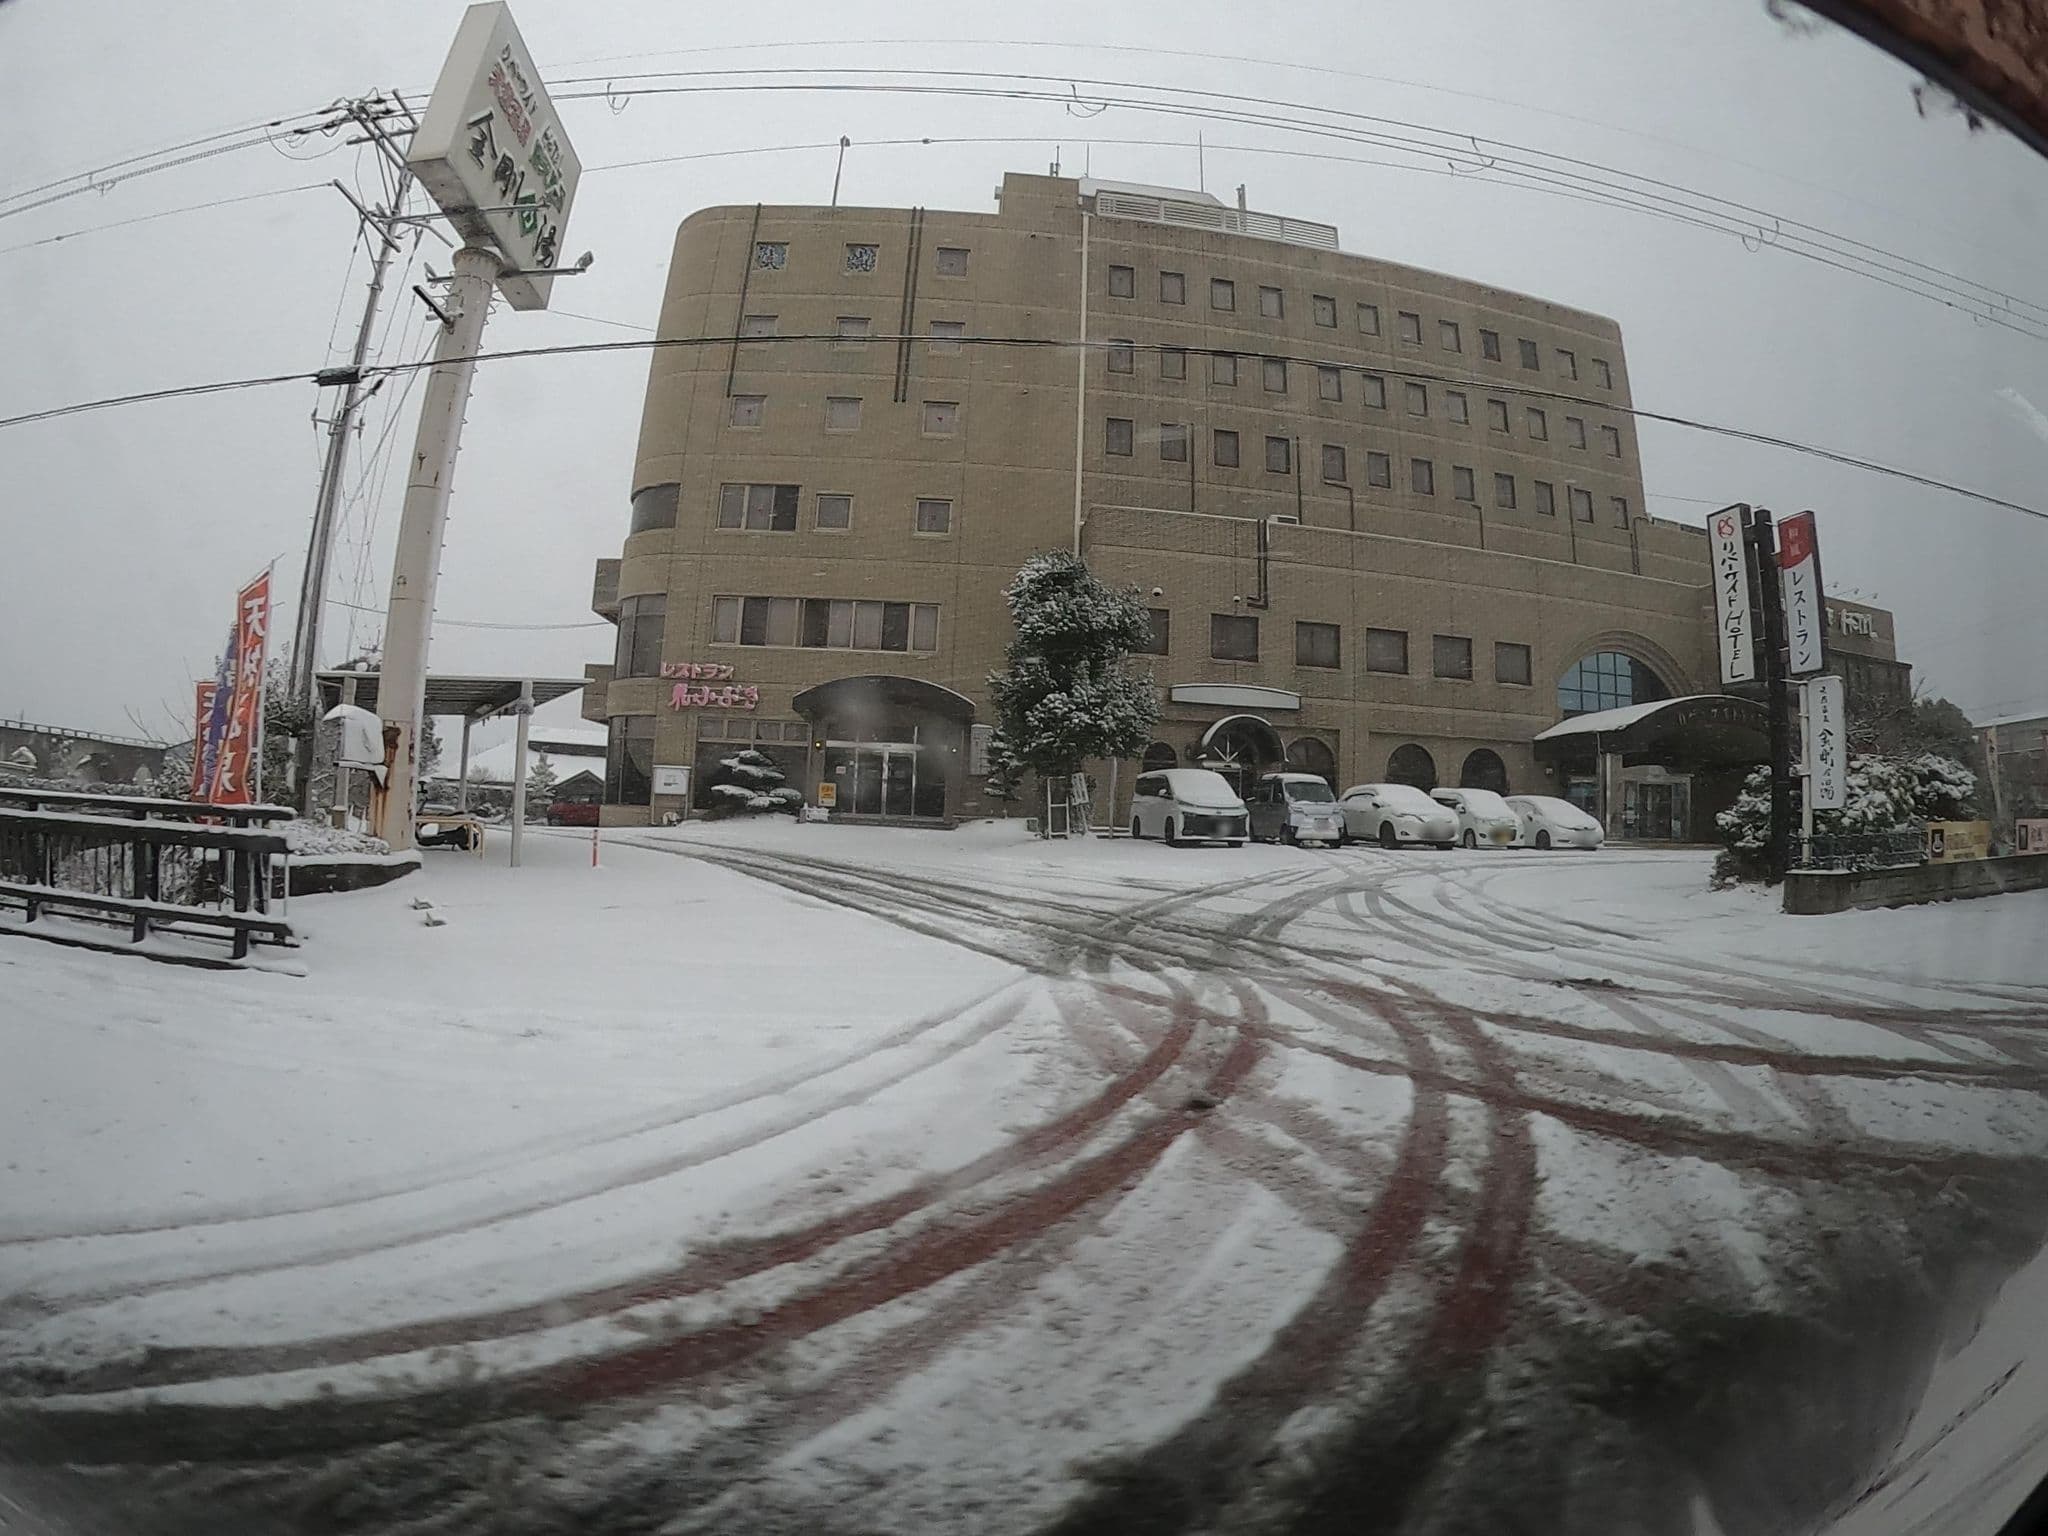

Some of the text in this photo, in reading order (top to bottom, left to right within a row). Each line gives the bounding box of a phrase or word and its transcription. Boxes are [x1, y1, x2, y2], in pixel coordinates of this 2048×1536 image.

[1792, 571, 1811, 665] レストラン
[661, 662, 734, 679] レストラン
